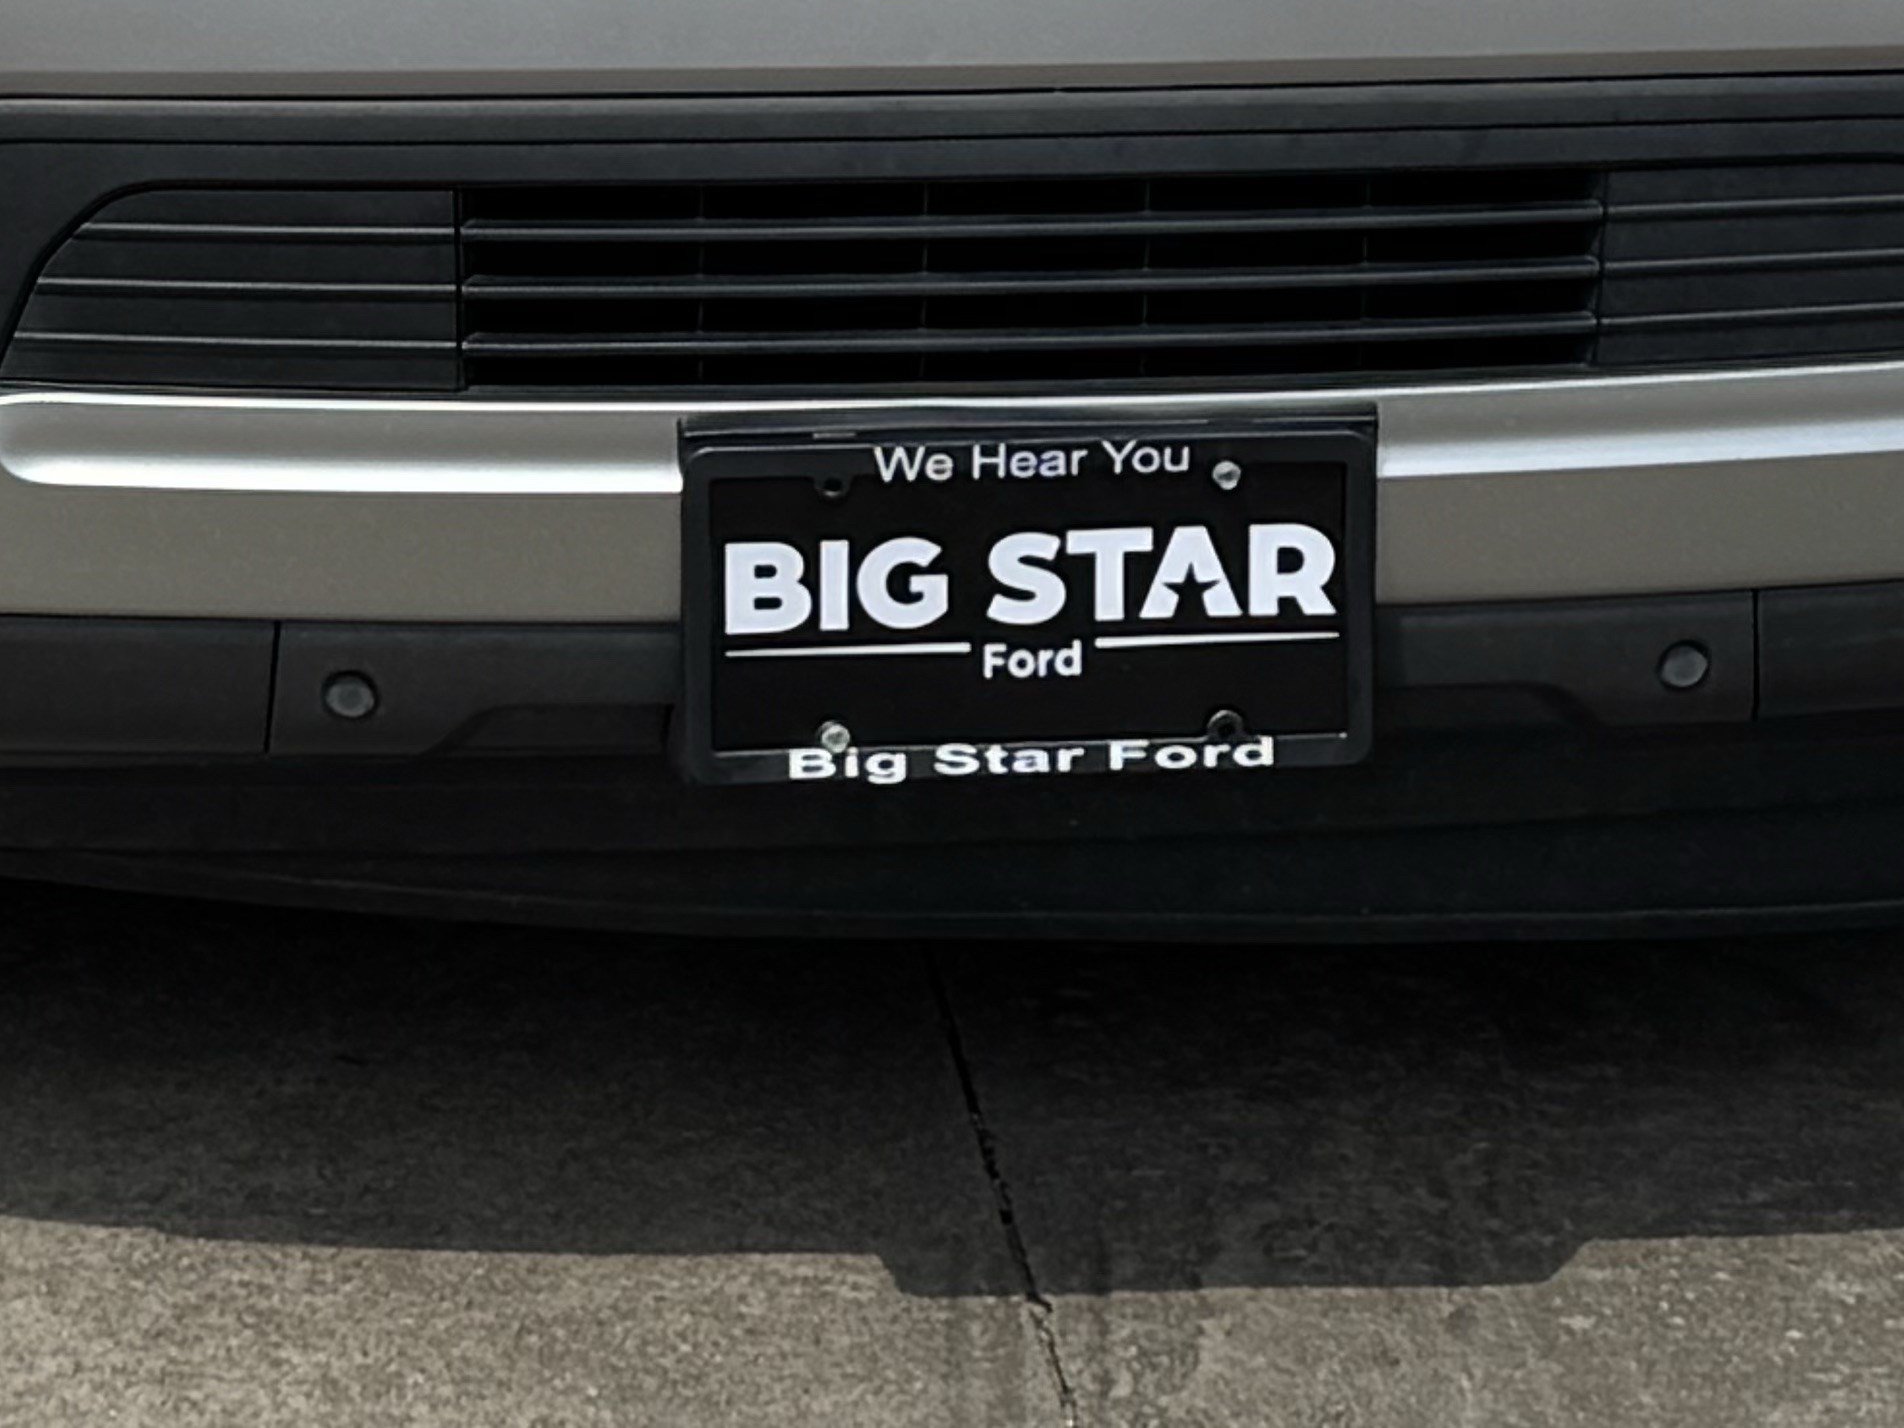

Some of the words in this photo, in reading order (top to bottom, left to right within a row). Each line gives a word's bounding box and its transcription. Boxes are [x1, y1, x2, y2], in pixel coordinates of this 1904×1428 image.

[874, 445, 954, 483] We
[972, 442, 1089, 480] Hear
[1102, 439, 1190, 475] You
[724, 536, 949, 635] BIG
[986, 522, 1338, 626] STAR
[983, 640, 1083, 679] Ford
[788, 746, 907, 784] Big
[933, 742, 1085, 775] Star
[1108, 736, 1275, 771] Ford
